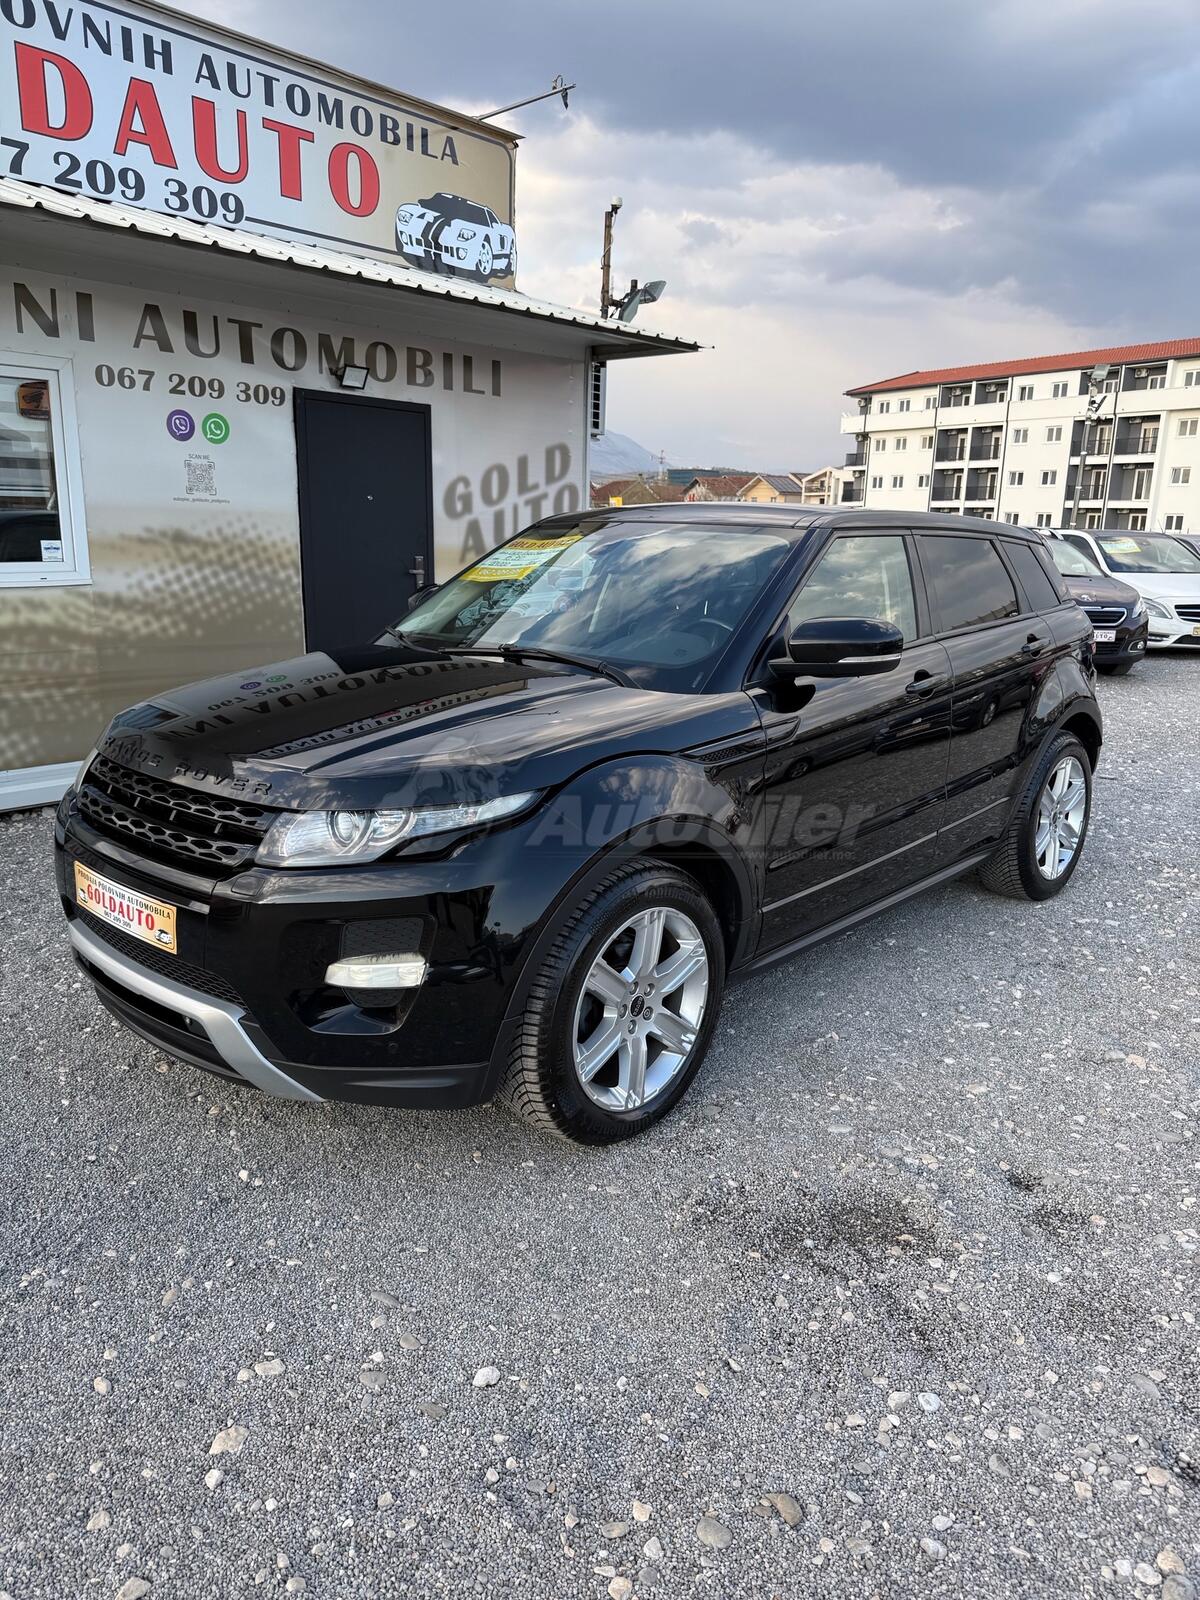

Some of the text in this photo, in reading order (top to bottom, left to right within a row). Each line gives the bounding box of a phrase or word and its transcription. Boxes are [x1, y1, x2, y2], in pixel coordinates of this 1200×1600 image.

[14, 40, 381, 217] DAUTO
[195, 53, 459, 166] AUTOMOBILA
[0, 136, 245, 225] 7 209 309
[13, 282, 502, 397] NI AUTOMOBILI
[95, 364, 286, 407] 067 209 309
[443, 442, 571, 520] GOLD
[459, 482, 580, 564] AUTO
[104, 737, 272, 795] RANGE ROVER
[87, 883, 155, 931] GOLDAUTO
[98, 880, 126, 901] POLOVNIH
[127, 893, 171, 920] AUTOMOBILA
